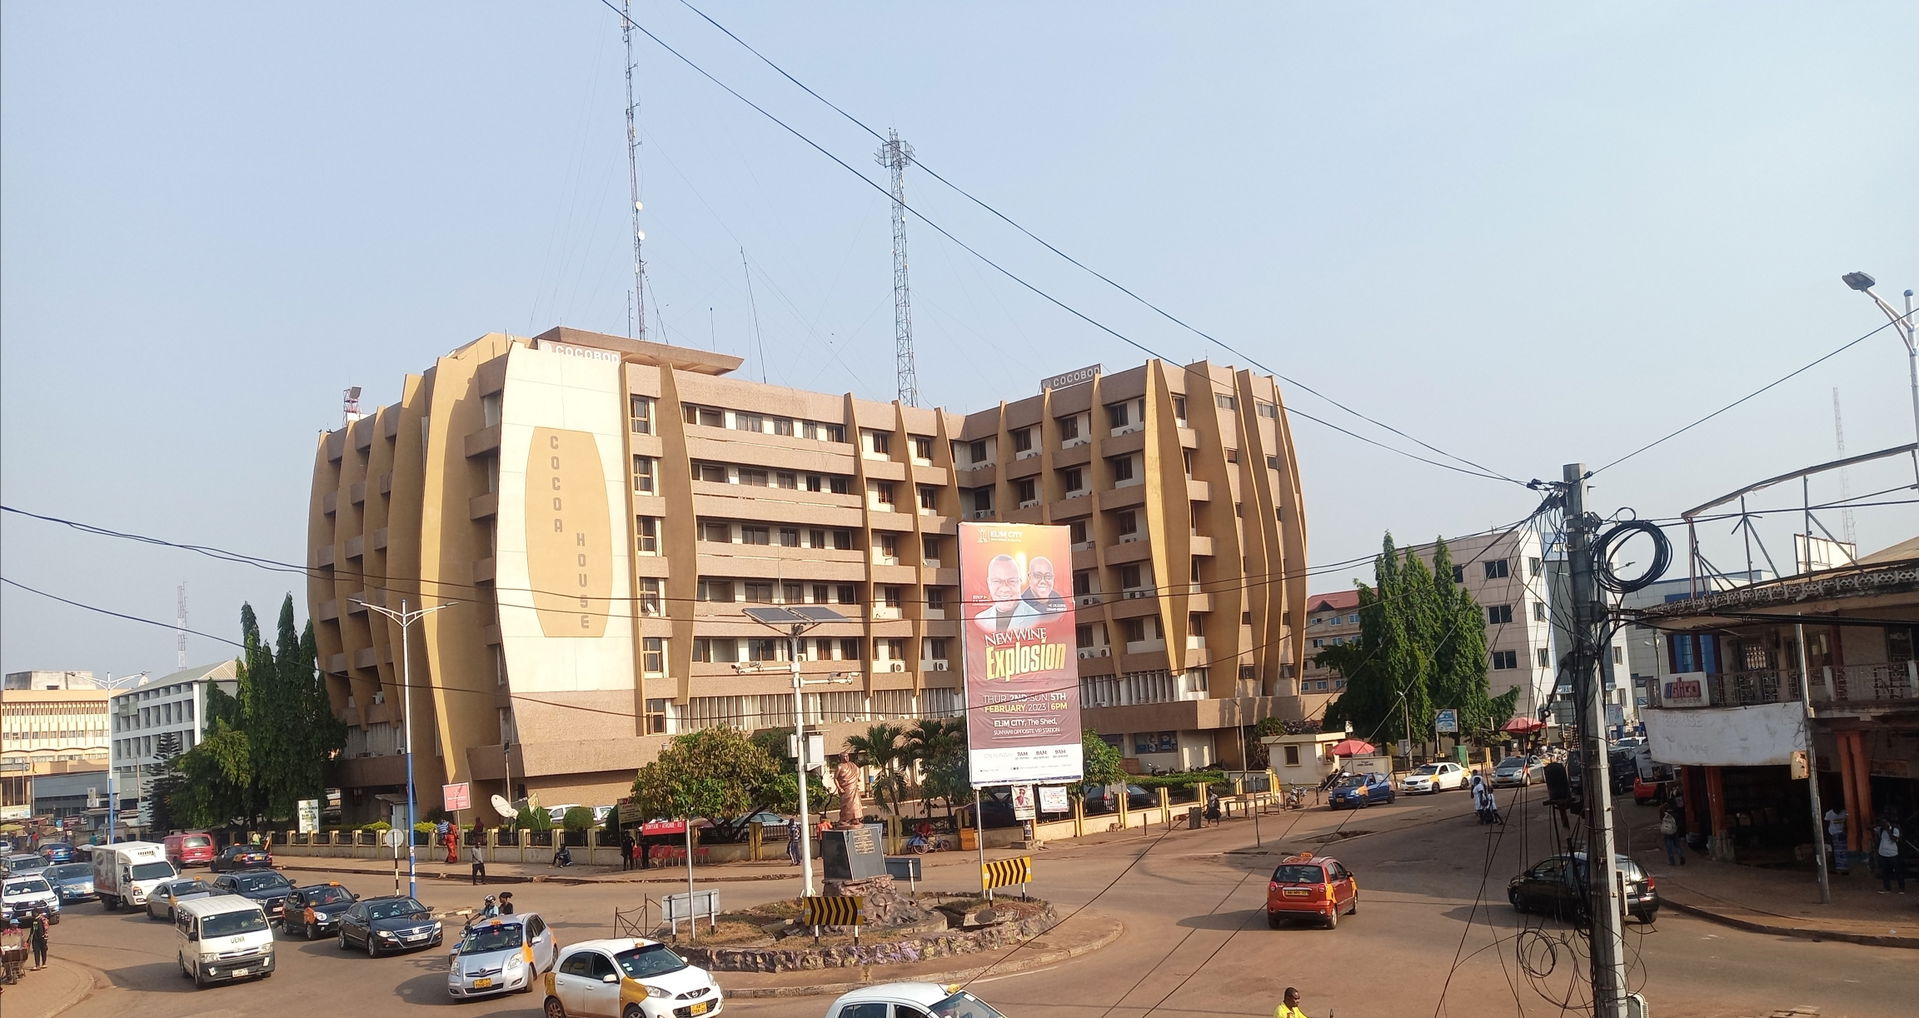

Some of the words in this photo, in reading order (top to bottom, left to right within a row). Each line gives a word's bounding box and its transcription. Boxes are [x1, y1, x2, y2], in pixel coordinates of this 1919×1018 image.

[555, 345, 619, 363] COCOBOD
[1053, 367, 1100, 387] COCOBOD
[550, 435, 563, 533] COCOA
[576, 533, 589, 629] HOUSE
[984, 632, 1013, 647] NEW
[1012, 627, 1047, 641] WINE
[985, 637, 1067, 682] Explosion
[1050, 692, 1067, 701] 5TH
[1028, 702, 1047, 712] 2023
[1050, 702, 1068, 711] 6PM
